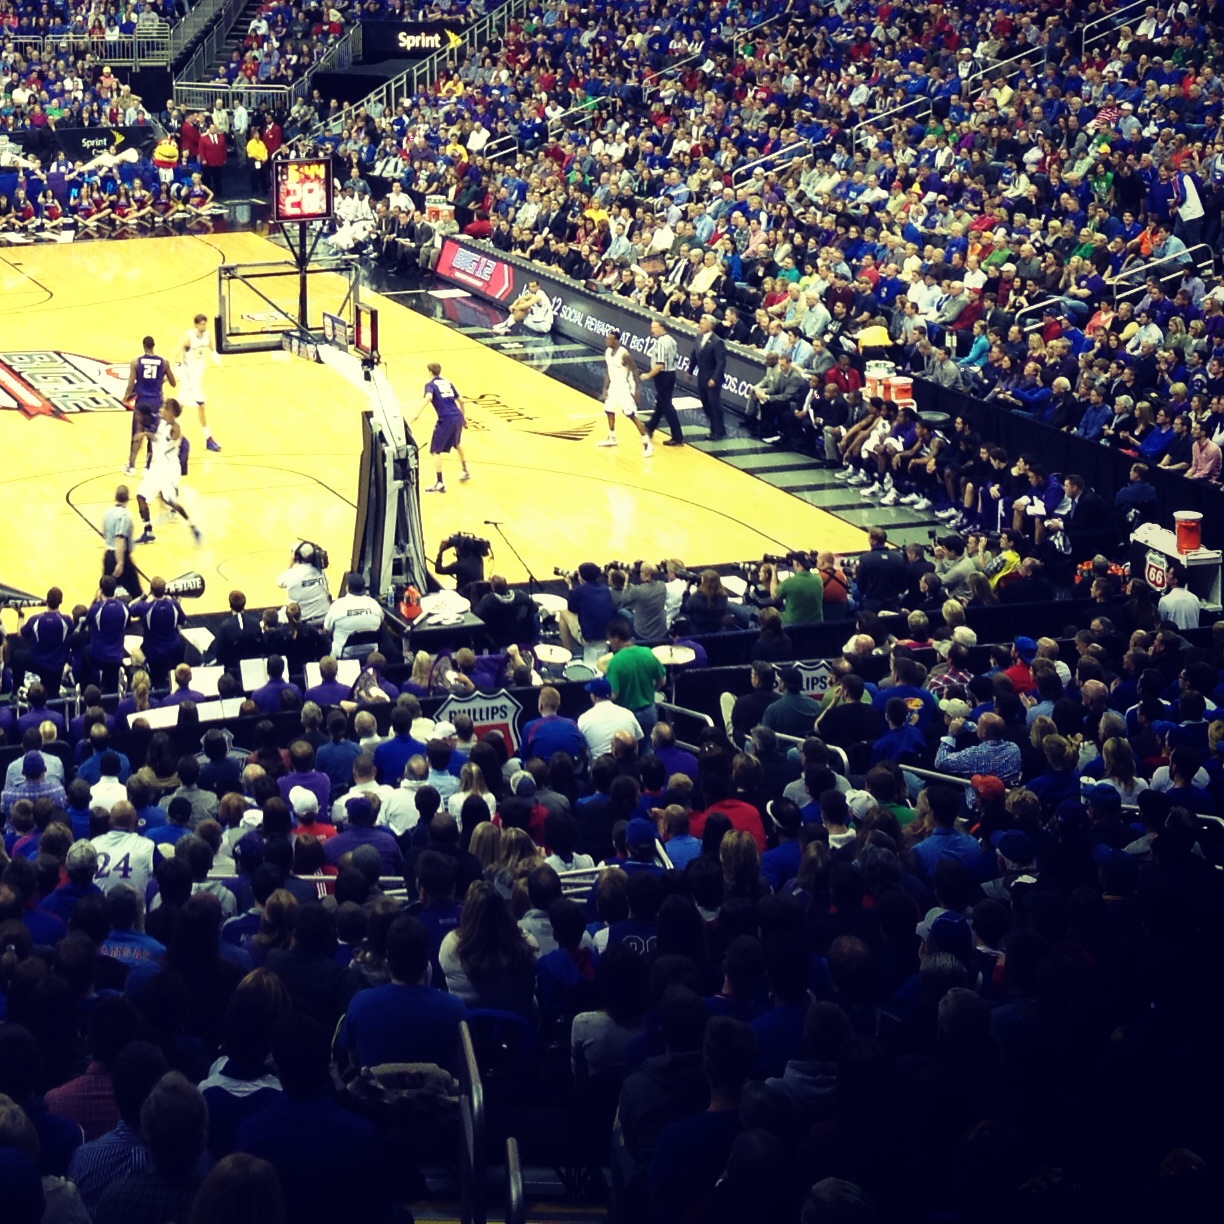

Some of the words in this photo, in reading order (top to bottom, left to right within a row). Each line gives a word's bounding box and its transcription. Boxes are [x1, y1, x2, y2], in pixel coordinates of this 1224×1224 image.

[398, 32, 441, 50] Sprint
[82, 138, 107, 147] Sprint
[286, 183, 320, 215] 28
[143, 365, 157, 379] 21
[301, 579, 324, 588] ESPN
[1149, 567, 1163, 584] 66
[449, 705, 508, 722] PILLIPS
[95, 852, 132, 879] 24
